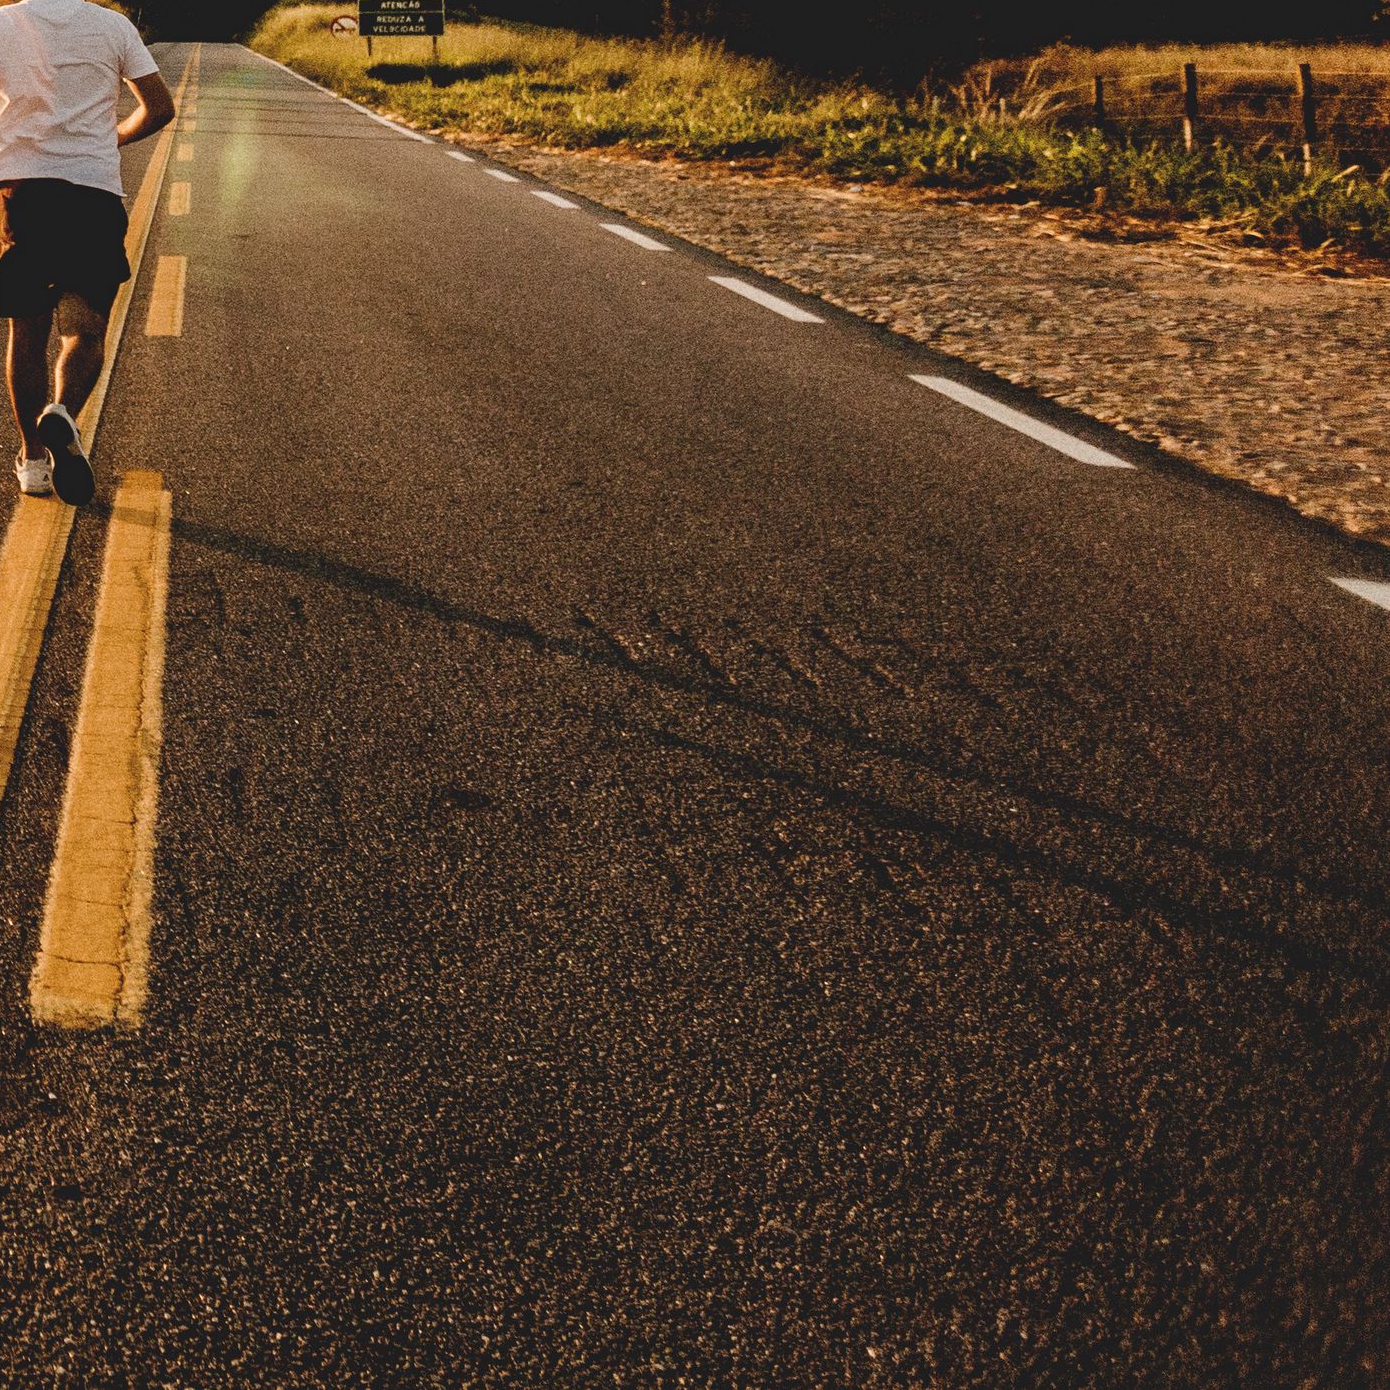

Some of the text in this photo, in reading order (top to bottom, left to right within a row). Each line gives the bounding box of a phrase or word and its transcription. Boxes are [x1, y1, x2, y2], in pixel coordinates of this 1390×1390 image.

[376, 15, 424, 23] REDUZA A
[372, 25, 426, 33] VELOCIDADE
